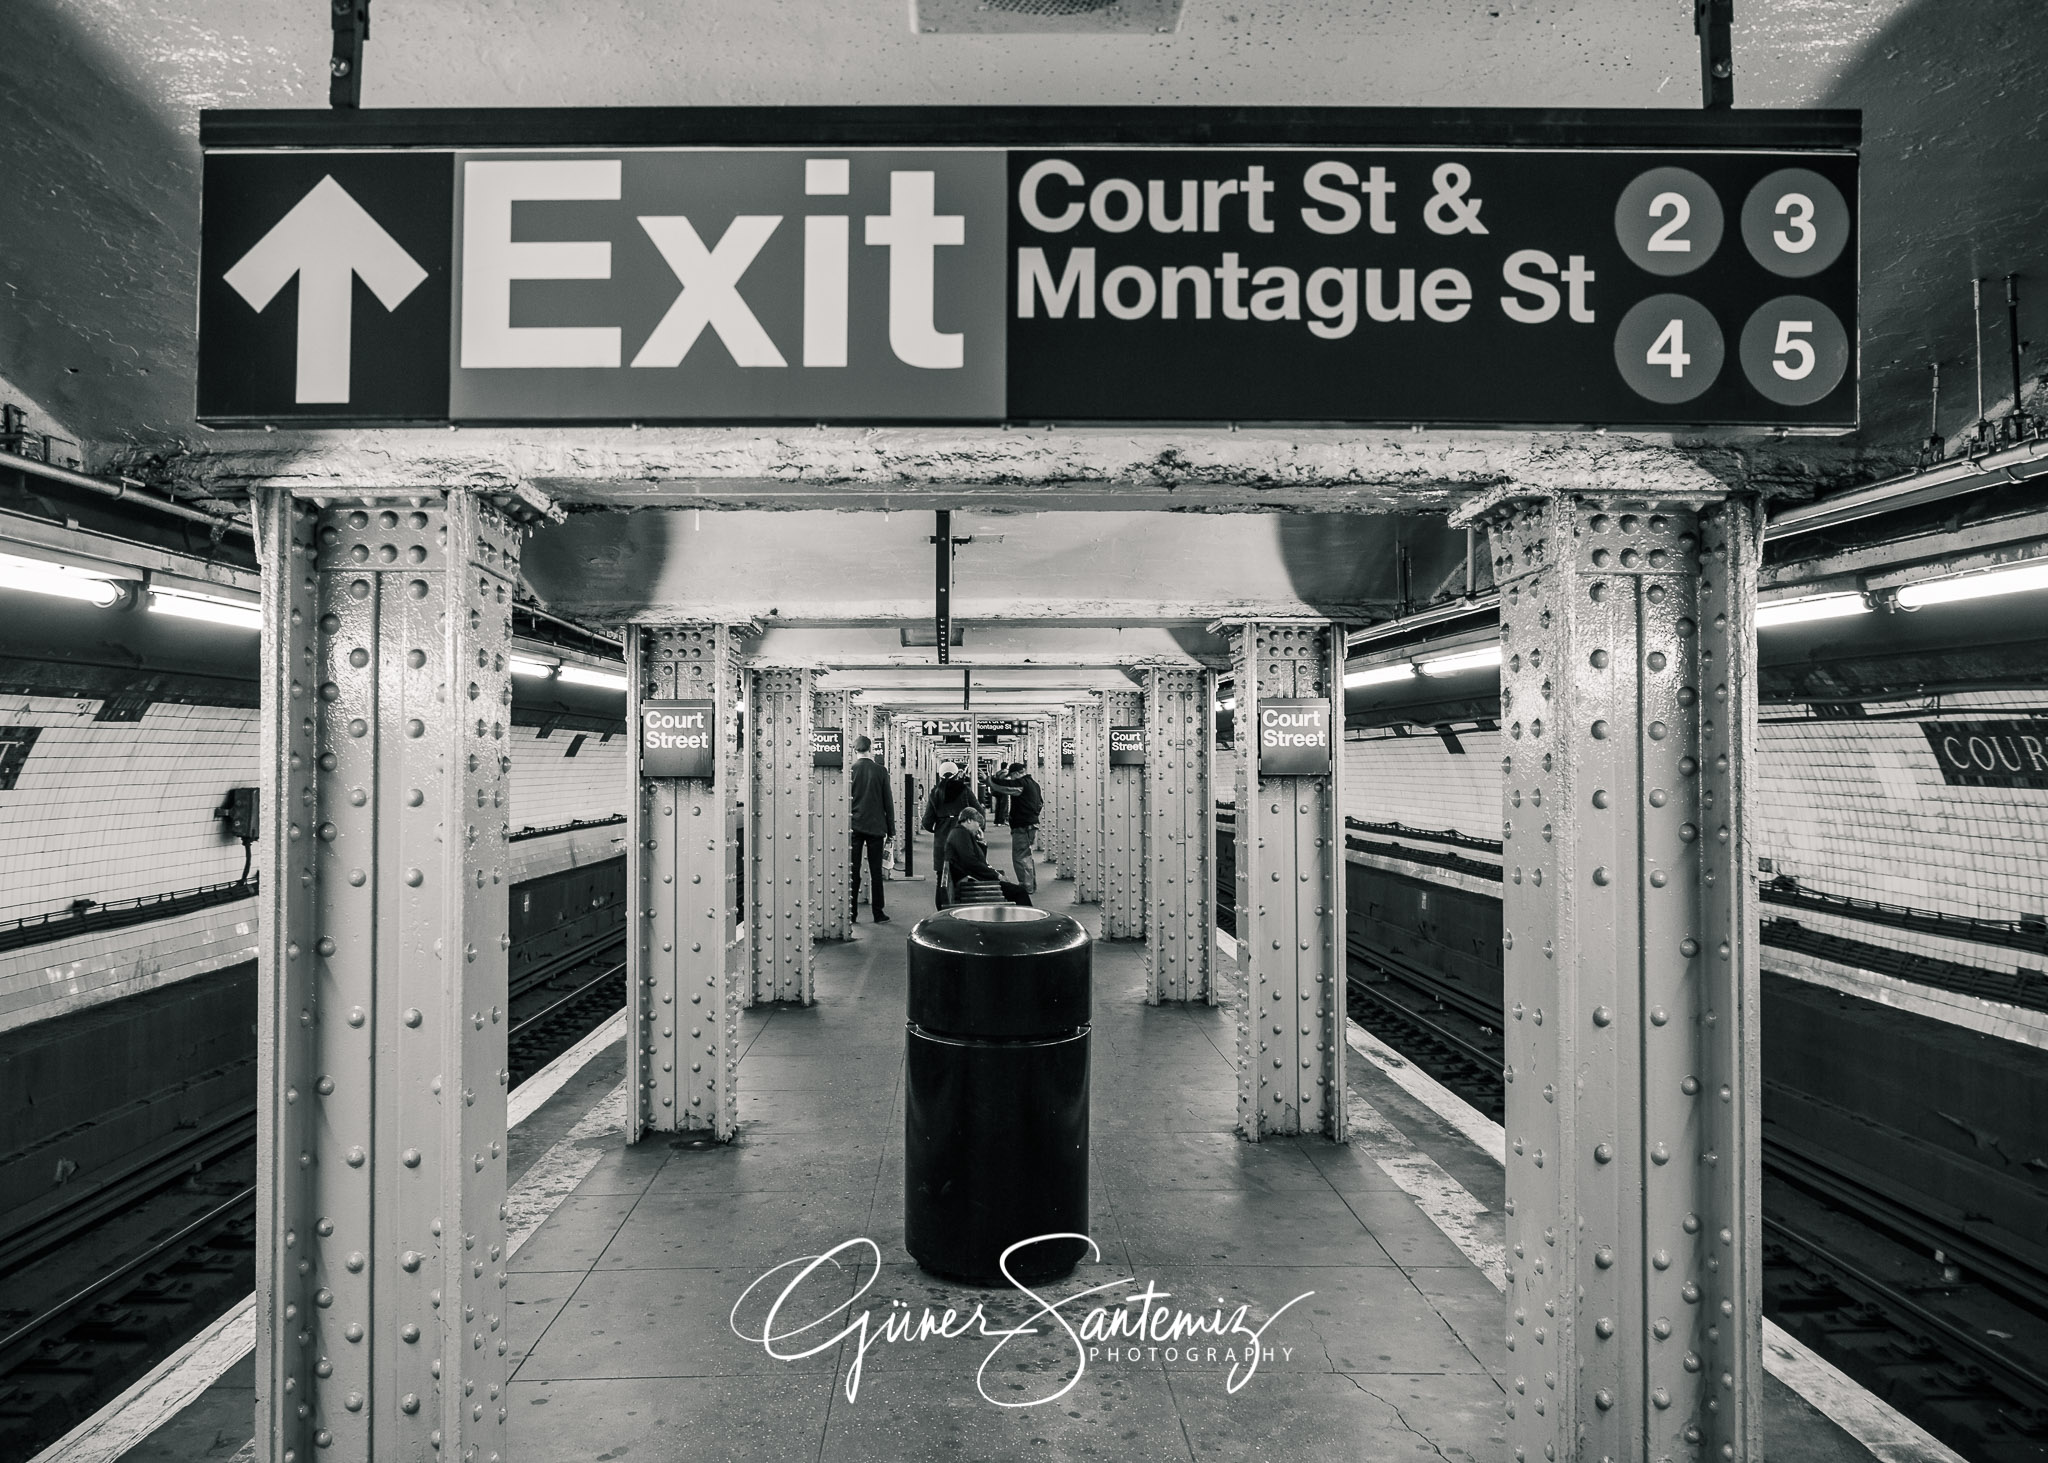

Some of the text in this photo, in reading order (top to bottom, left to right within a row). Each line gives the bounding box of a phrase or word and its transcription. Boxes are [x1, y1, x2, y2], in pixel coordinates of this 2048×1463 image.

[1018, 159, 1490, 236] Court St &
[1647, 192, 1817, 254] 2 3
[461, 160, 965, 369] Exit
[1016, 247, 1595, 340] Montague St
[1646, 319, 1816, 381] 4 5
[645, 711, 704, 729] Court
[1262, 709, 1321, 727] Court
[645, 731, 709, 749] Street
[1111, 732, 1141, 741] Court
[1111, 742, 1143, 751] Street
[1263, 729, 1326, 747] Street
[1944, 736, 2048, 771] COUR
